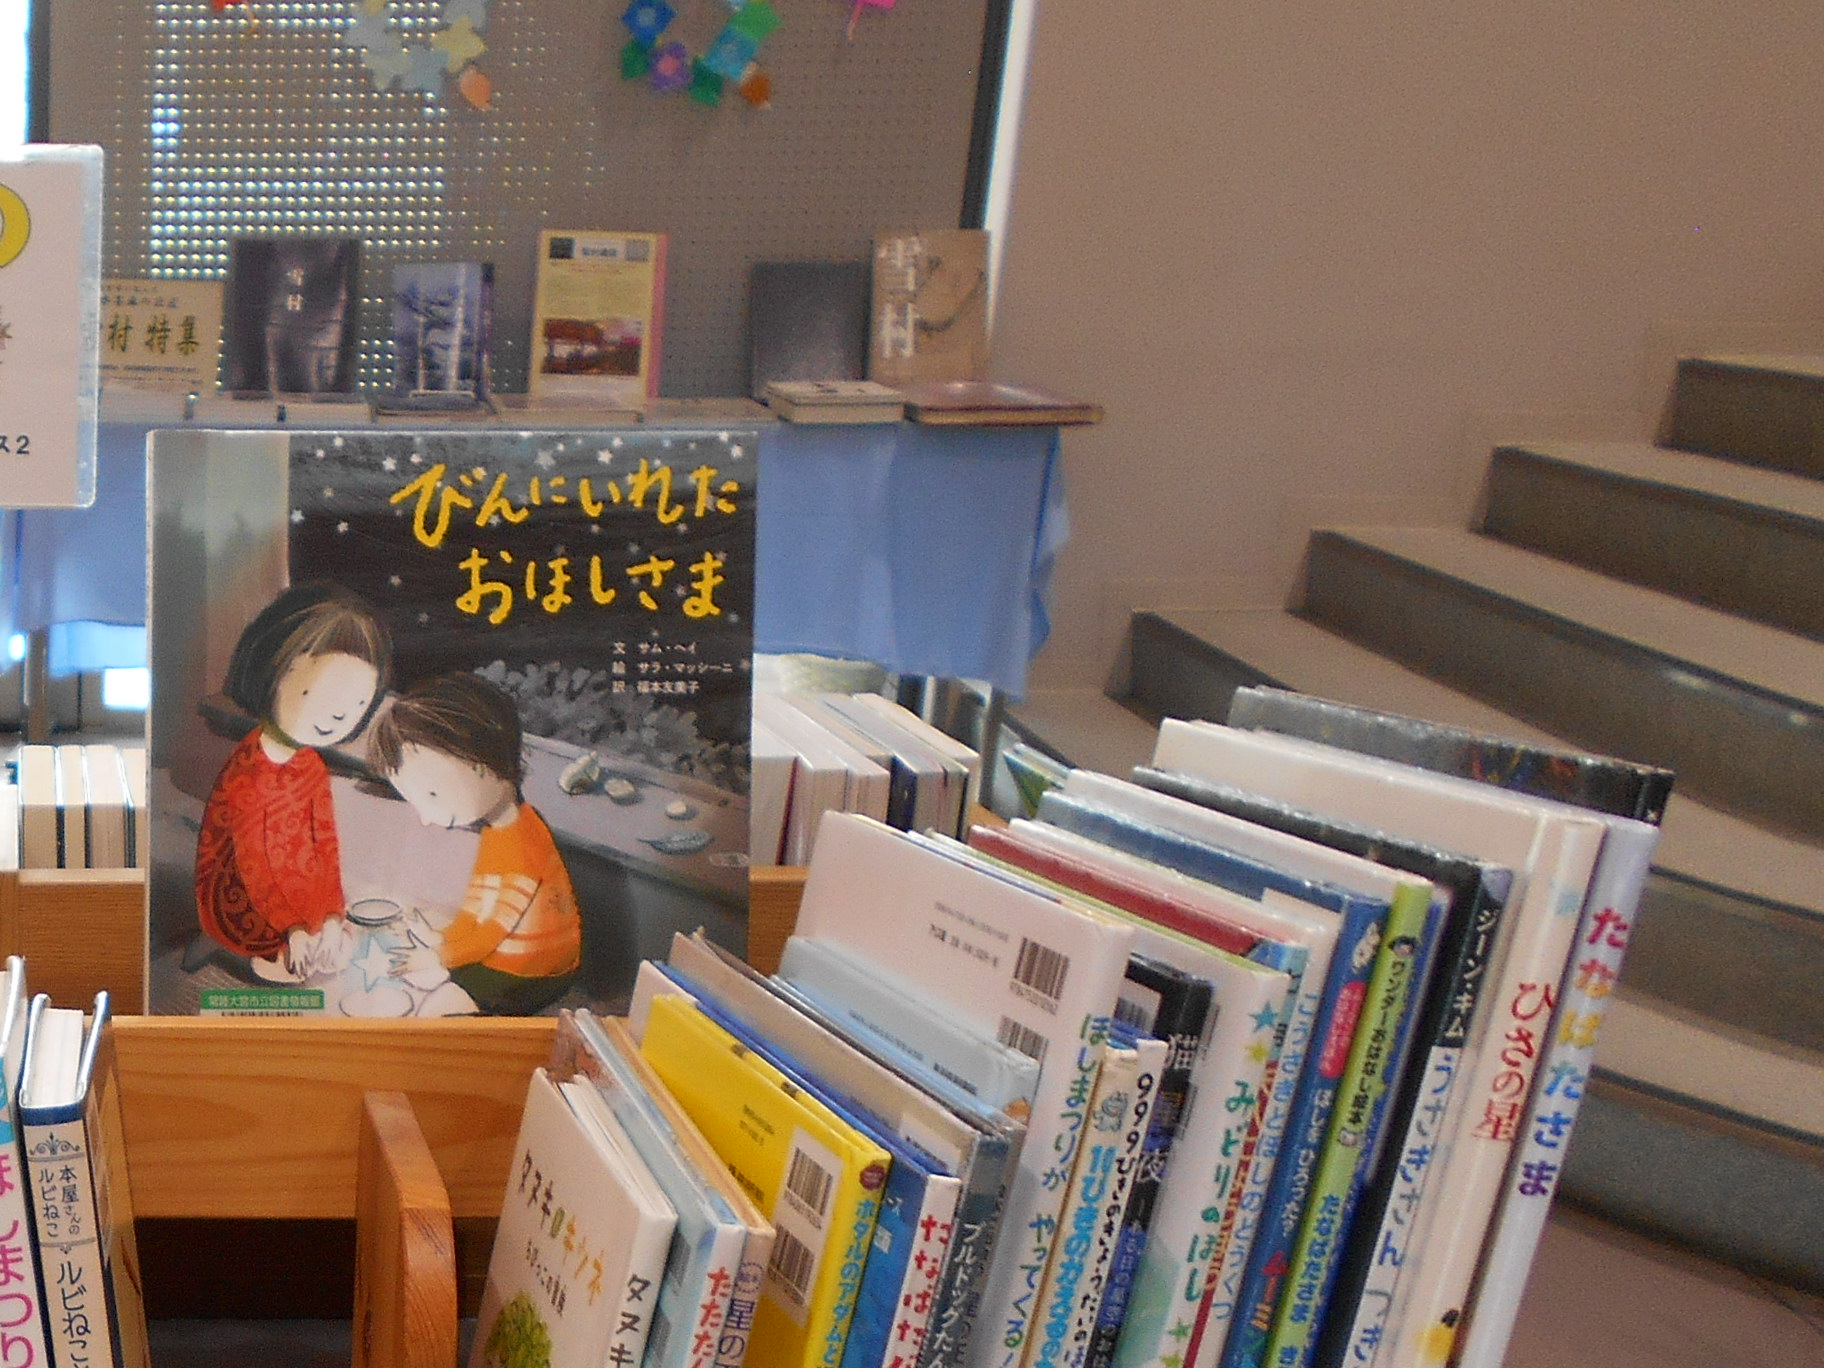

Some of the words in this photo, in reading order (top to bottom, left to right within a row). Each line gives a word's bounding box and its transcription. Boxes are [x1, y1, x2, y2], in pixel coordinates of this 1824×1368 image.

[392, 459, 738, 547] びんにいれた
[456, 550, 724, 624] おほしさま
[1474, 981, 1557, 1142] ひさの星
[1517, 906, 1630, 1197] たなばたさま
[39, 1168, 60, 1239] ルビねこ
[60, 1164, 81, 1236] 本屋さんの
[823, 1199, 876, 1365] ホタルのアダムと
